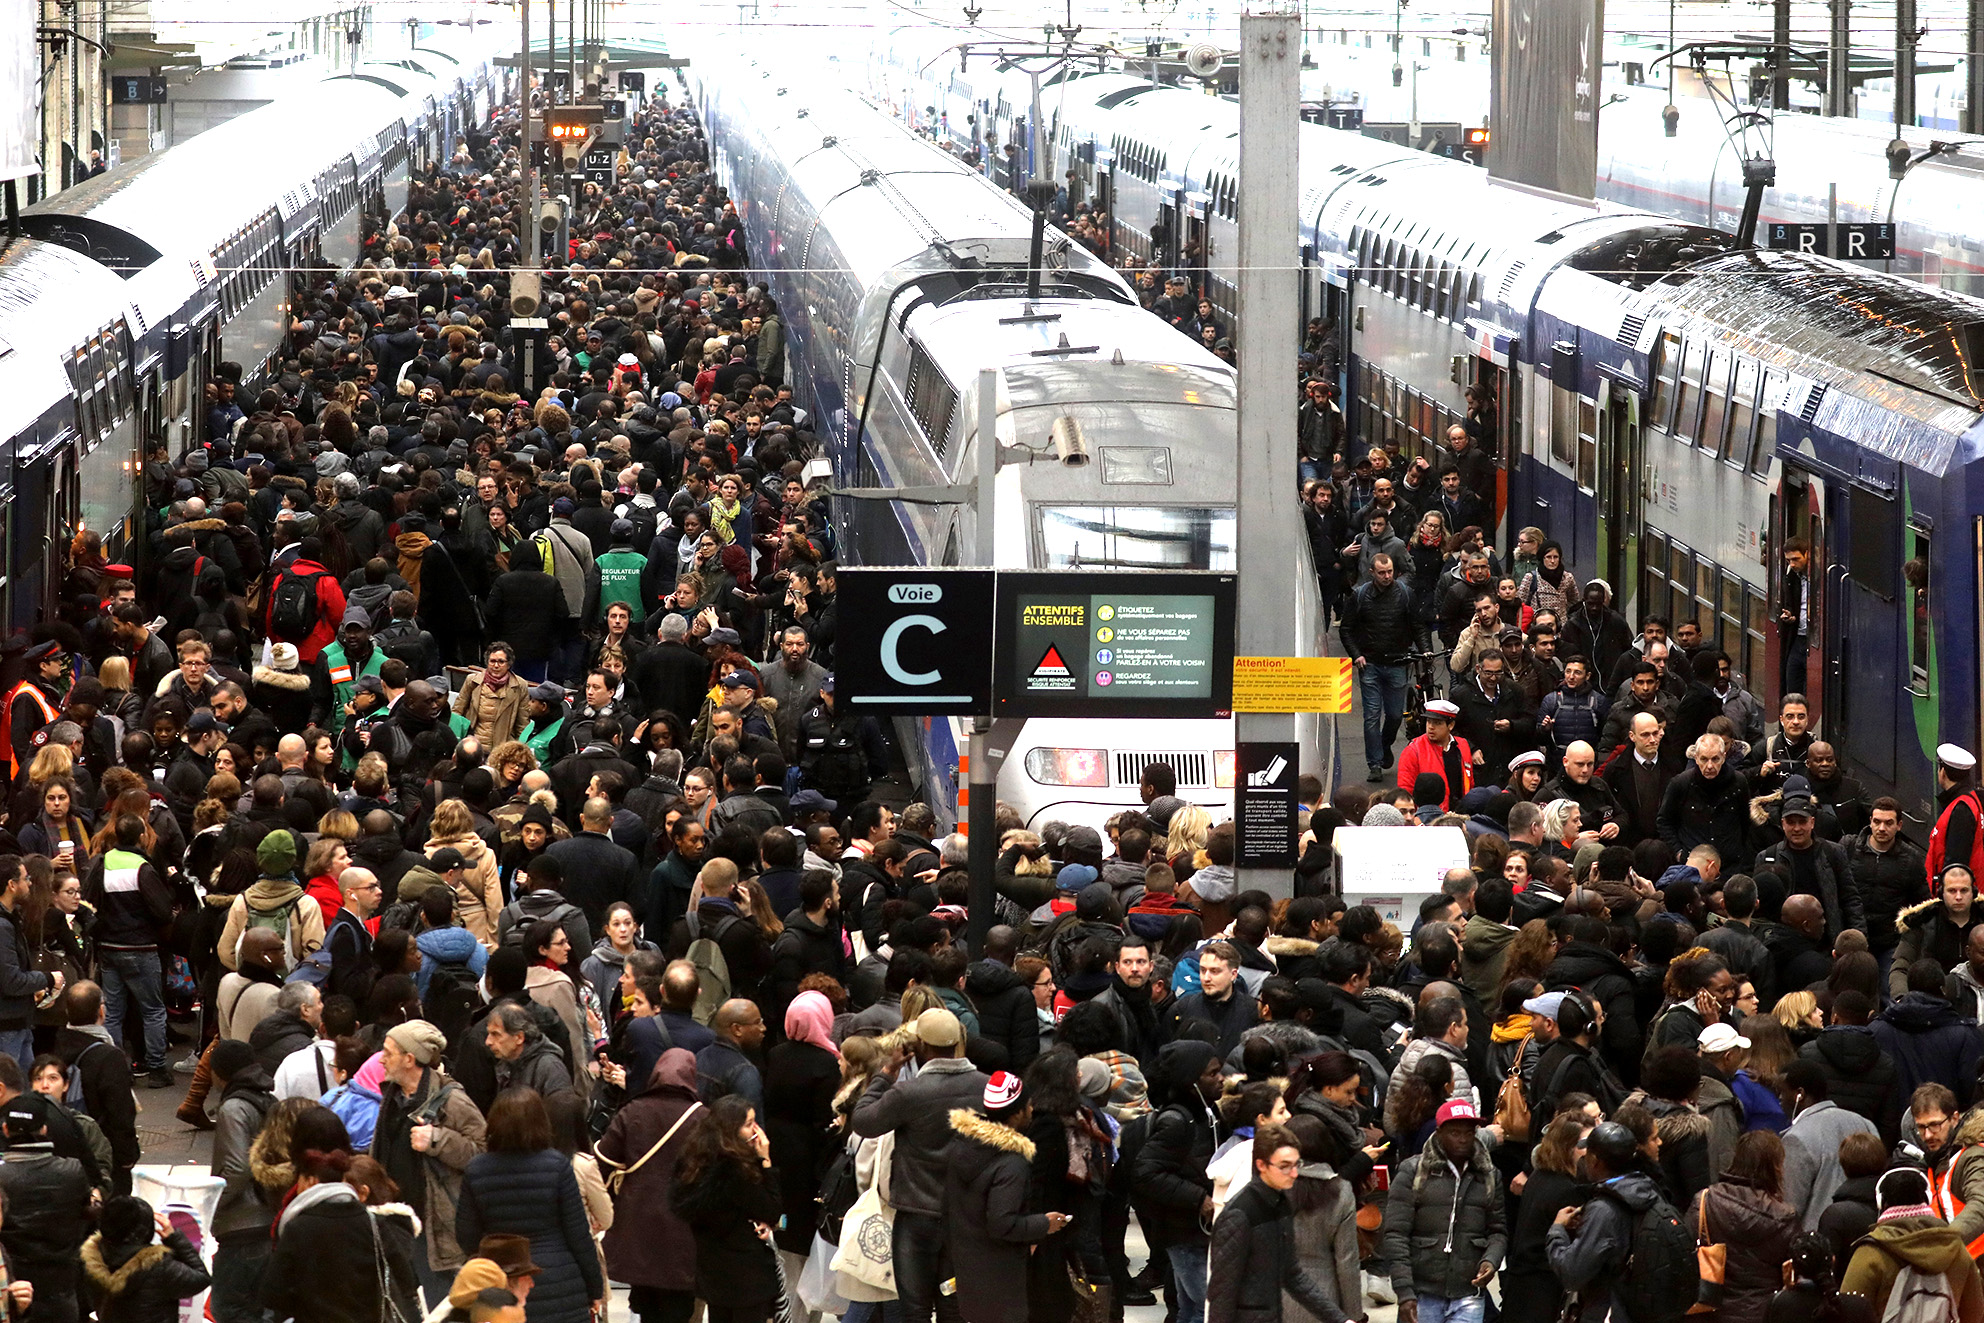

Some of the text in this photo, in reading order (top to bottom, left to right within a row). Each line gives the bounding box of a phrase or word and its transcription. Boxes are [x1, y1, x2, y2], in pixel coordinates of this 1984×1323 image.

[128, 86, 137, 98] B
[1336, 114, 1346, 128] T
[1776, 230, 1784, 238] D
[1800, 232, 1816, 254] R
[1848, 232, 1866, 256] R
[896, 587, 934, 600] Voie
[1023, 606, 1084, 615] ATTENTIFS
[1024, 616, 1084, 625] ENSEMBLE
[880, 614, 948, 686] C
